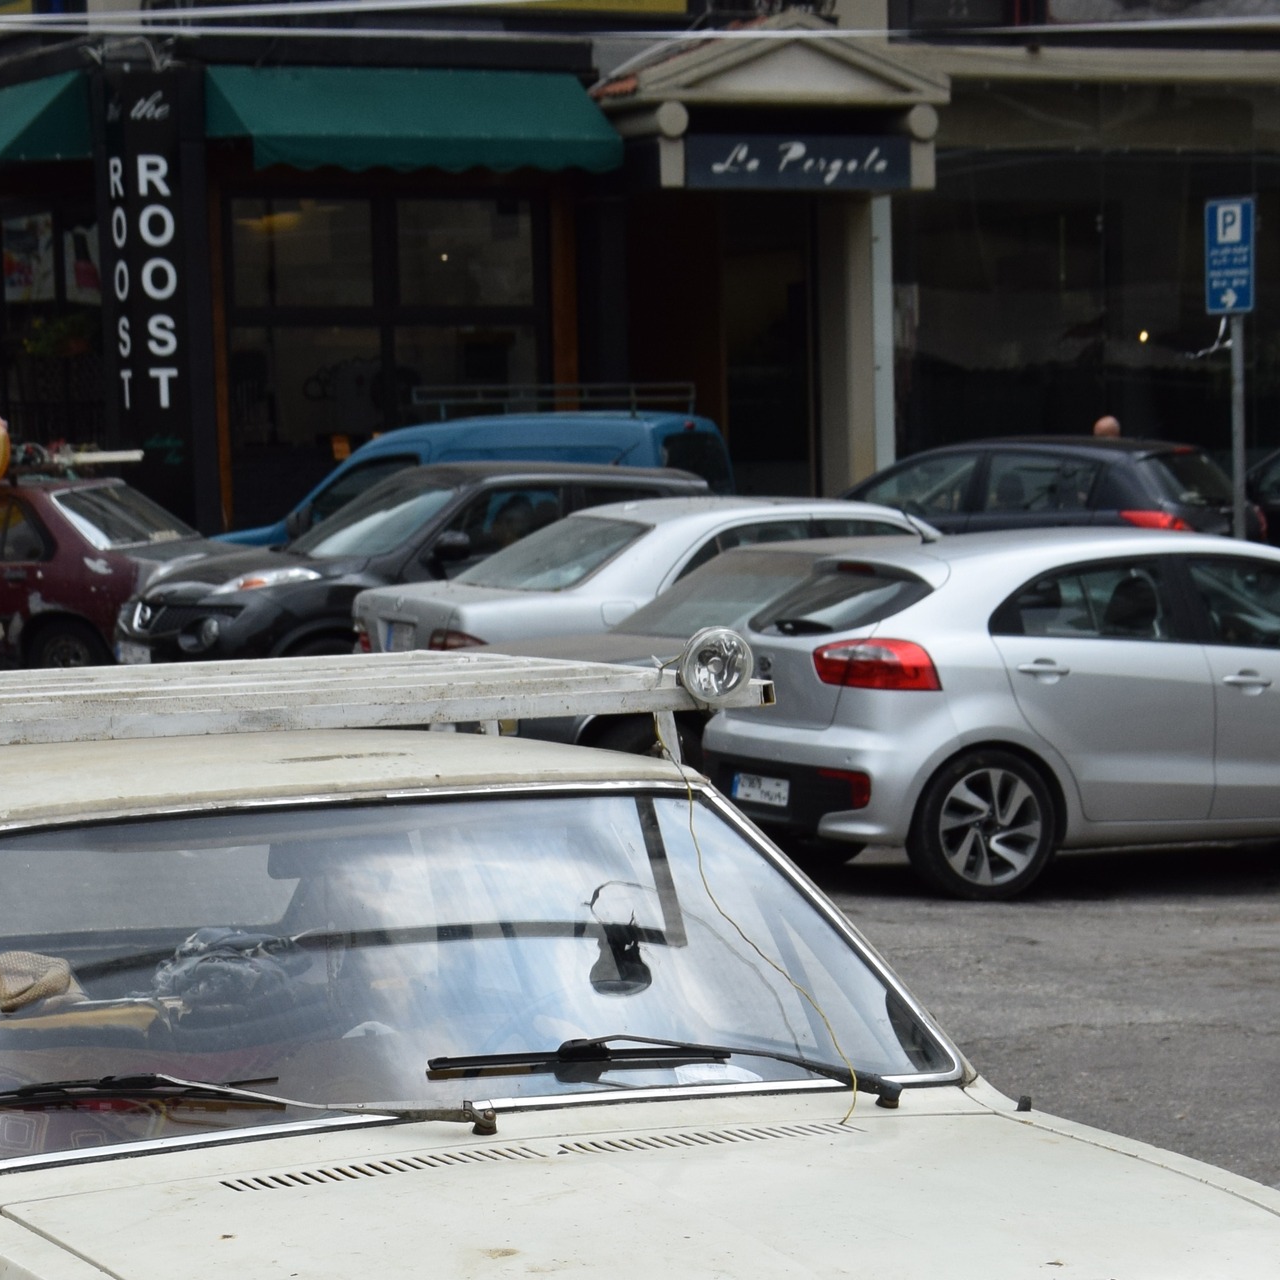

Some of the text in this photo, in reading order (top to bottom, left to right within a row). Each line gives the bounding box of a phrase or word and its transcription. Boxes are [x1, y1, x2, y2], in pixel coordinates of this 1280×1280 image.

[130, 90, 170, 121] the
[109, 156, 132, 410] ROOST
[136, 154, 178, 409] ROOST
[1222, 209, 1237, 238] P
